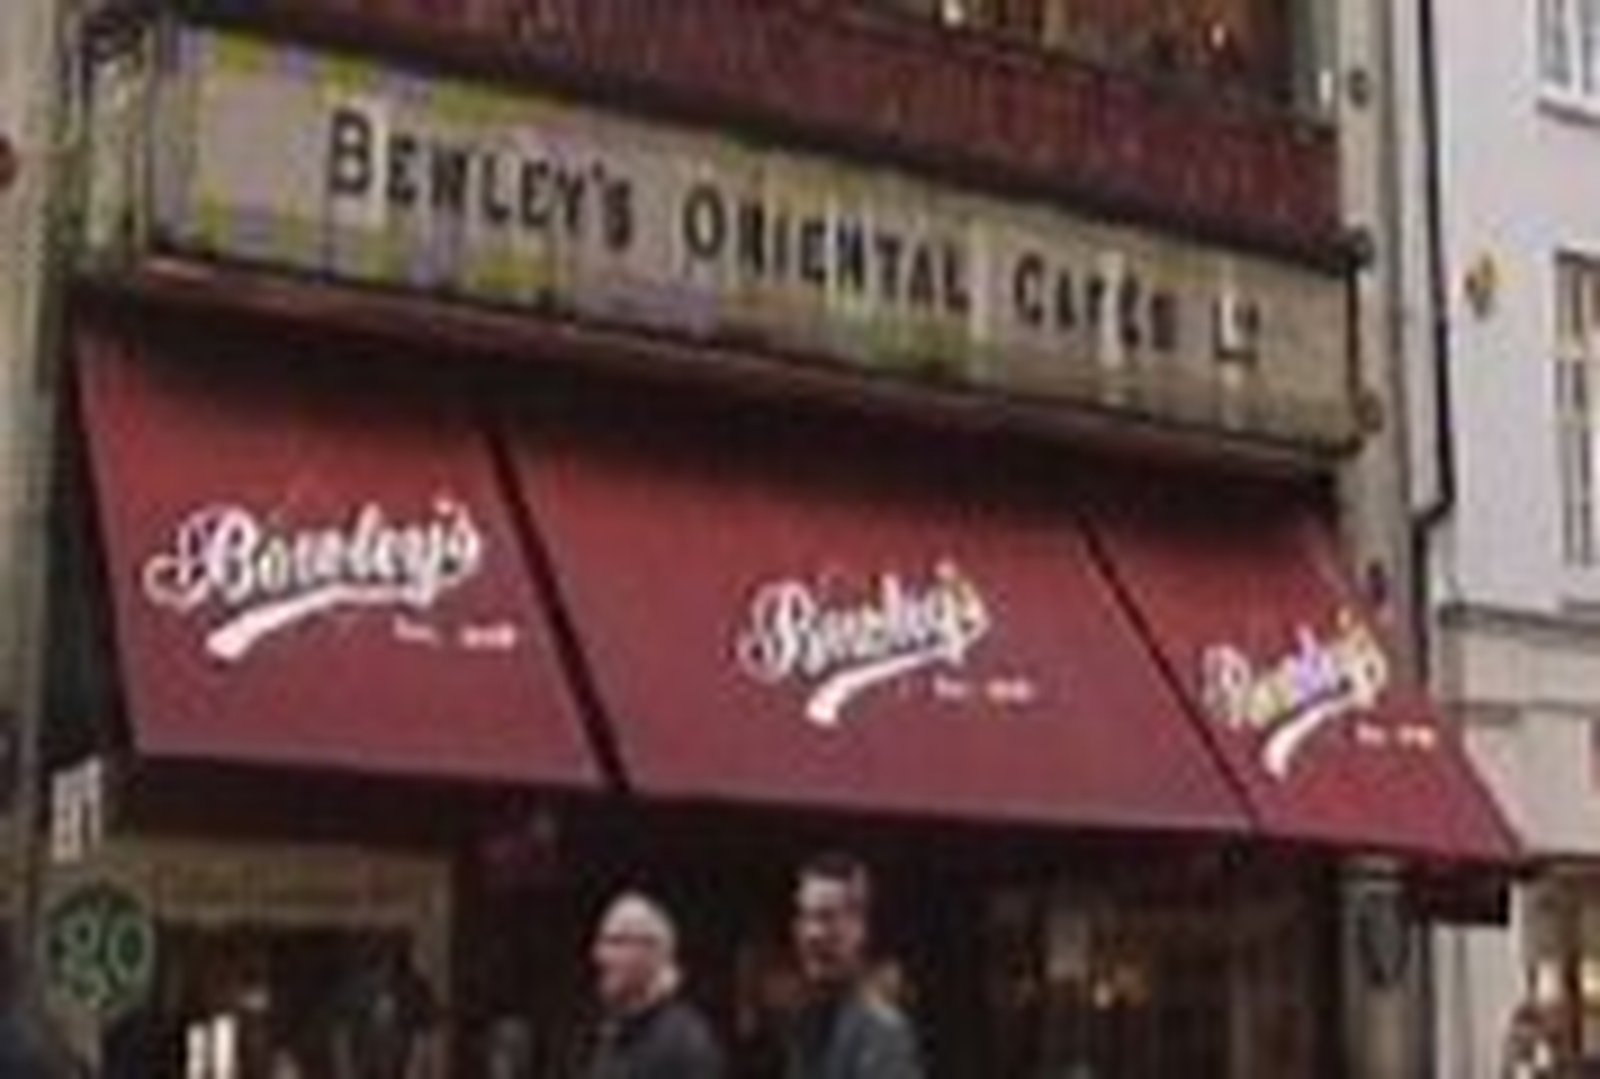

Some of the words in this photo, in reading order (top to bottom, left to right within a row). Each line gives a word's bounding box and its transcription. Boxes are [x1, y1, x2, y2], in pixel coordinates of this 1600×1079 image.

[328, 108, 634, 252] BEWLEY'S
[682, 183, 971, 313] ORIENTAL
[144, 496, 482, 608] Bewley's
[738, 560, 992, 681] Bewley's
